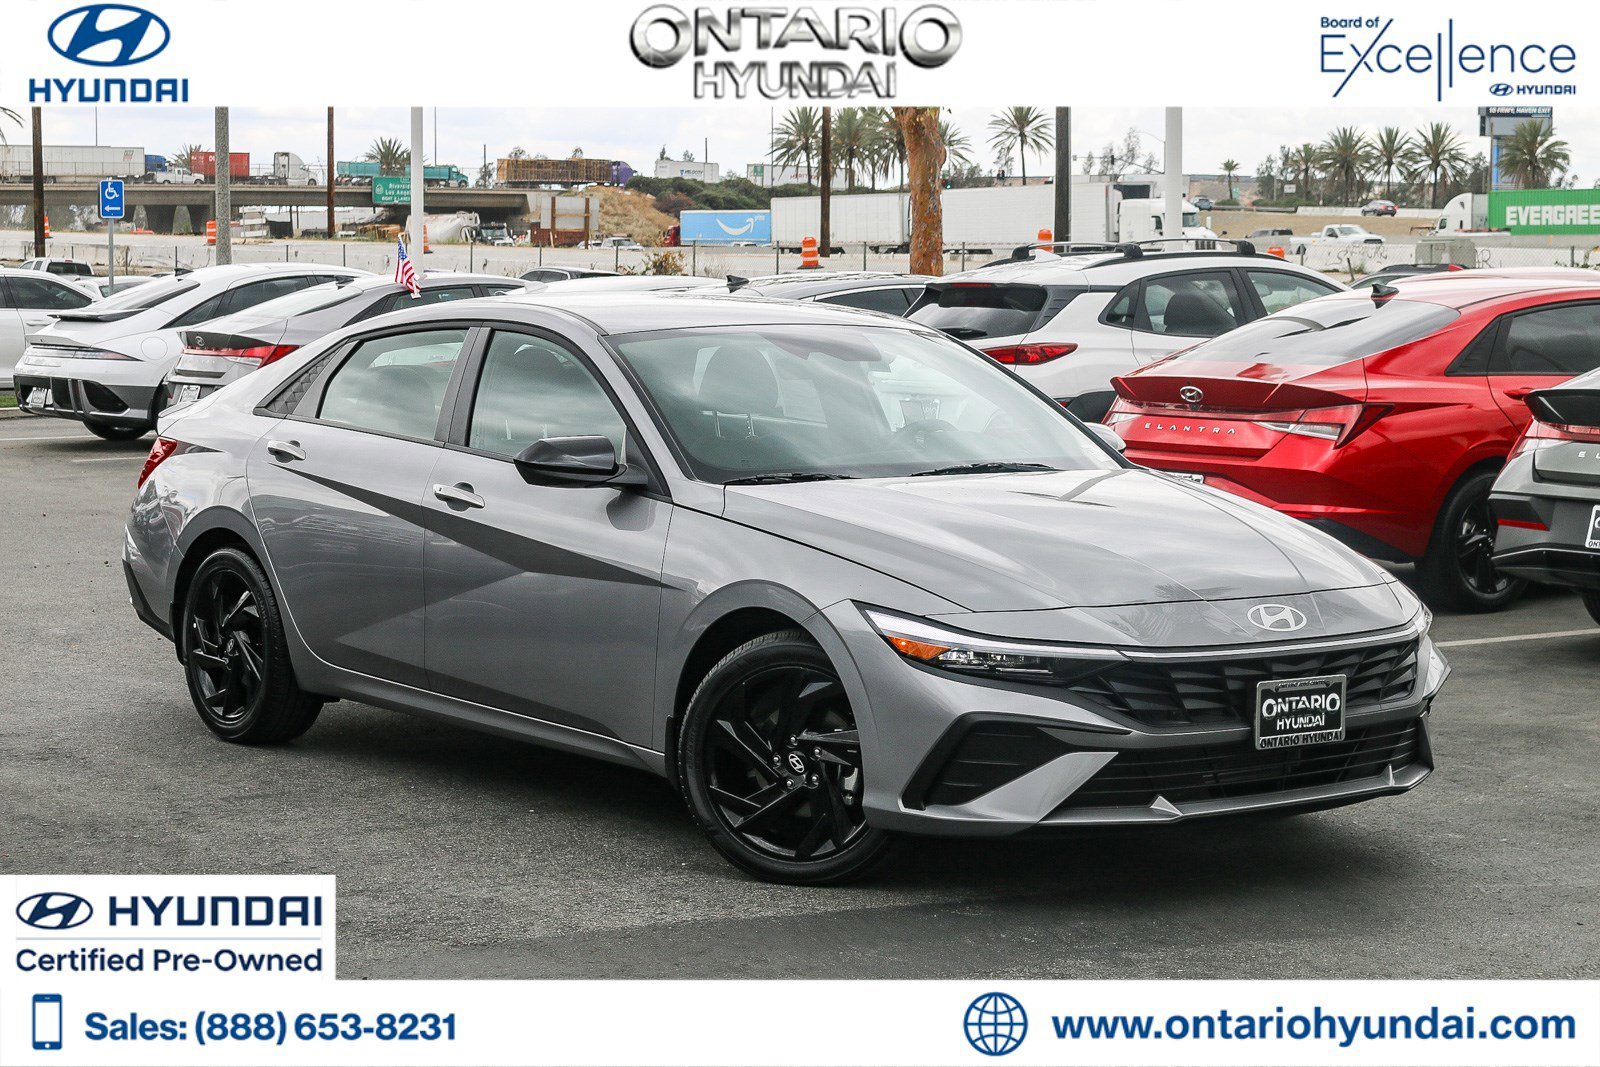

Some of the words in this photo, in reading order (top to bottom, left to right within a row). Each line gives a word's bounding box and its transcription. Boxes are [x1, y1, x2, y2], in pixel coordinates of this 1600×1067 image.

[1144, 422, 1236, 434] ELANTRA
[1262, 692, 1341, 719] ONTARIO
[1276, 712, 1325, 730] HYUNDAI
[1260, 734, 1300, 749] ONTARIO
[1302, 729, 1342, 744] HYUNDAI
